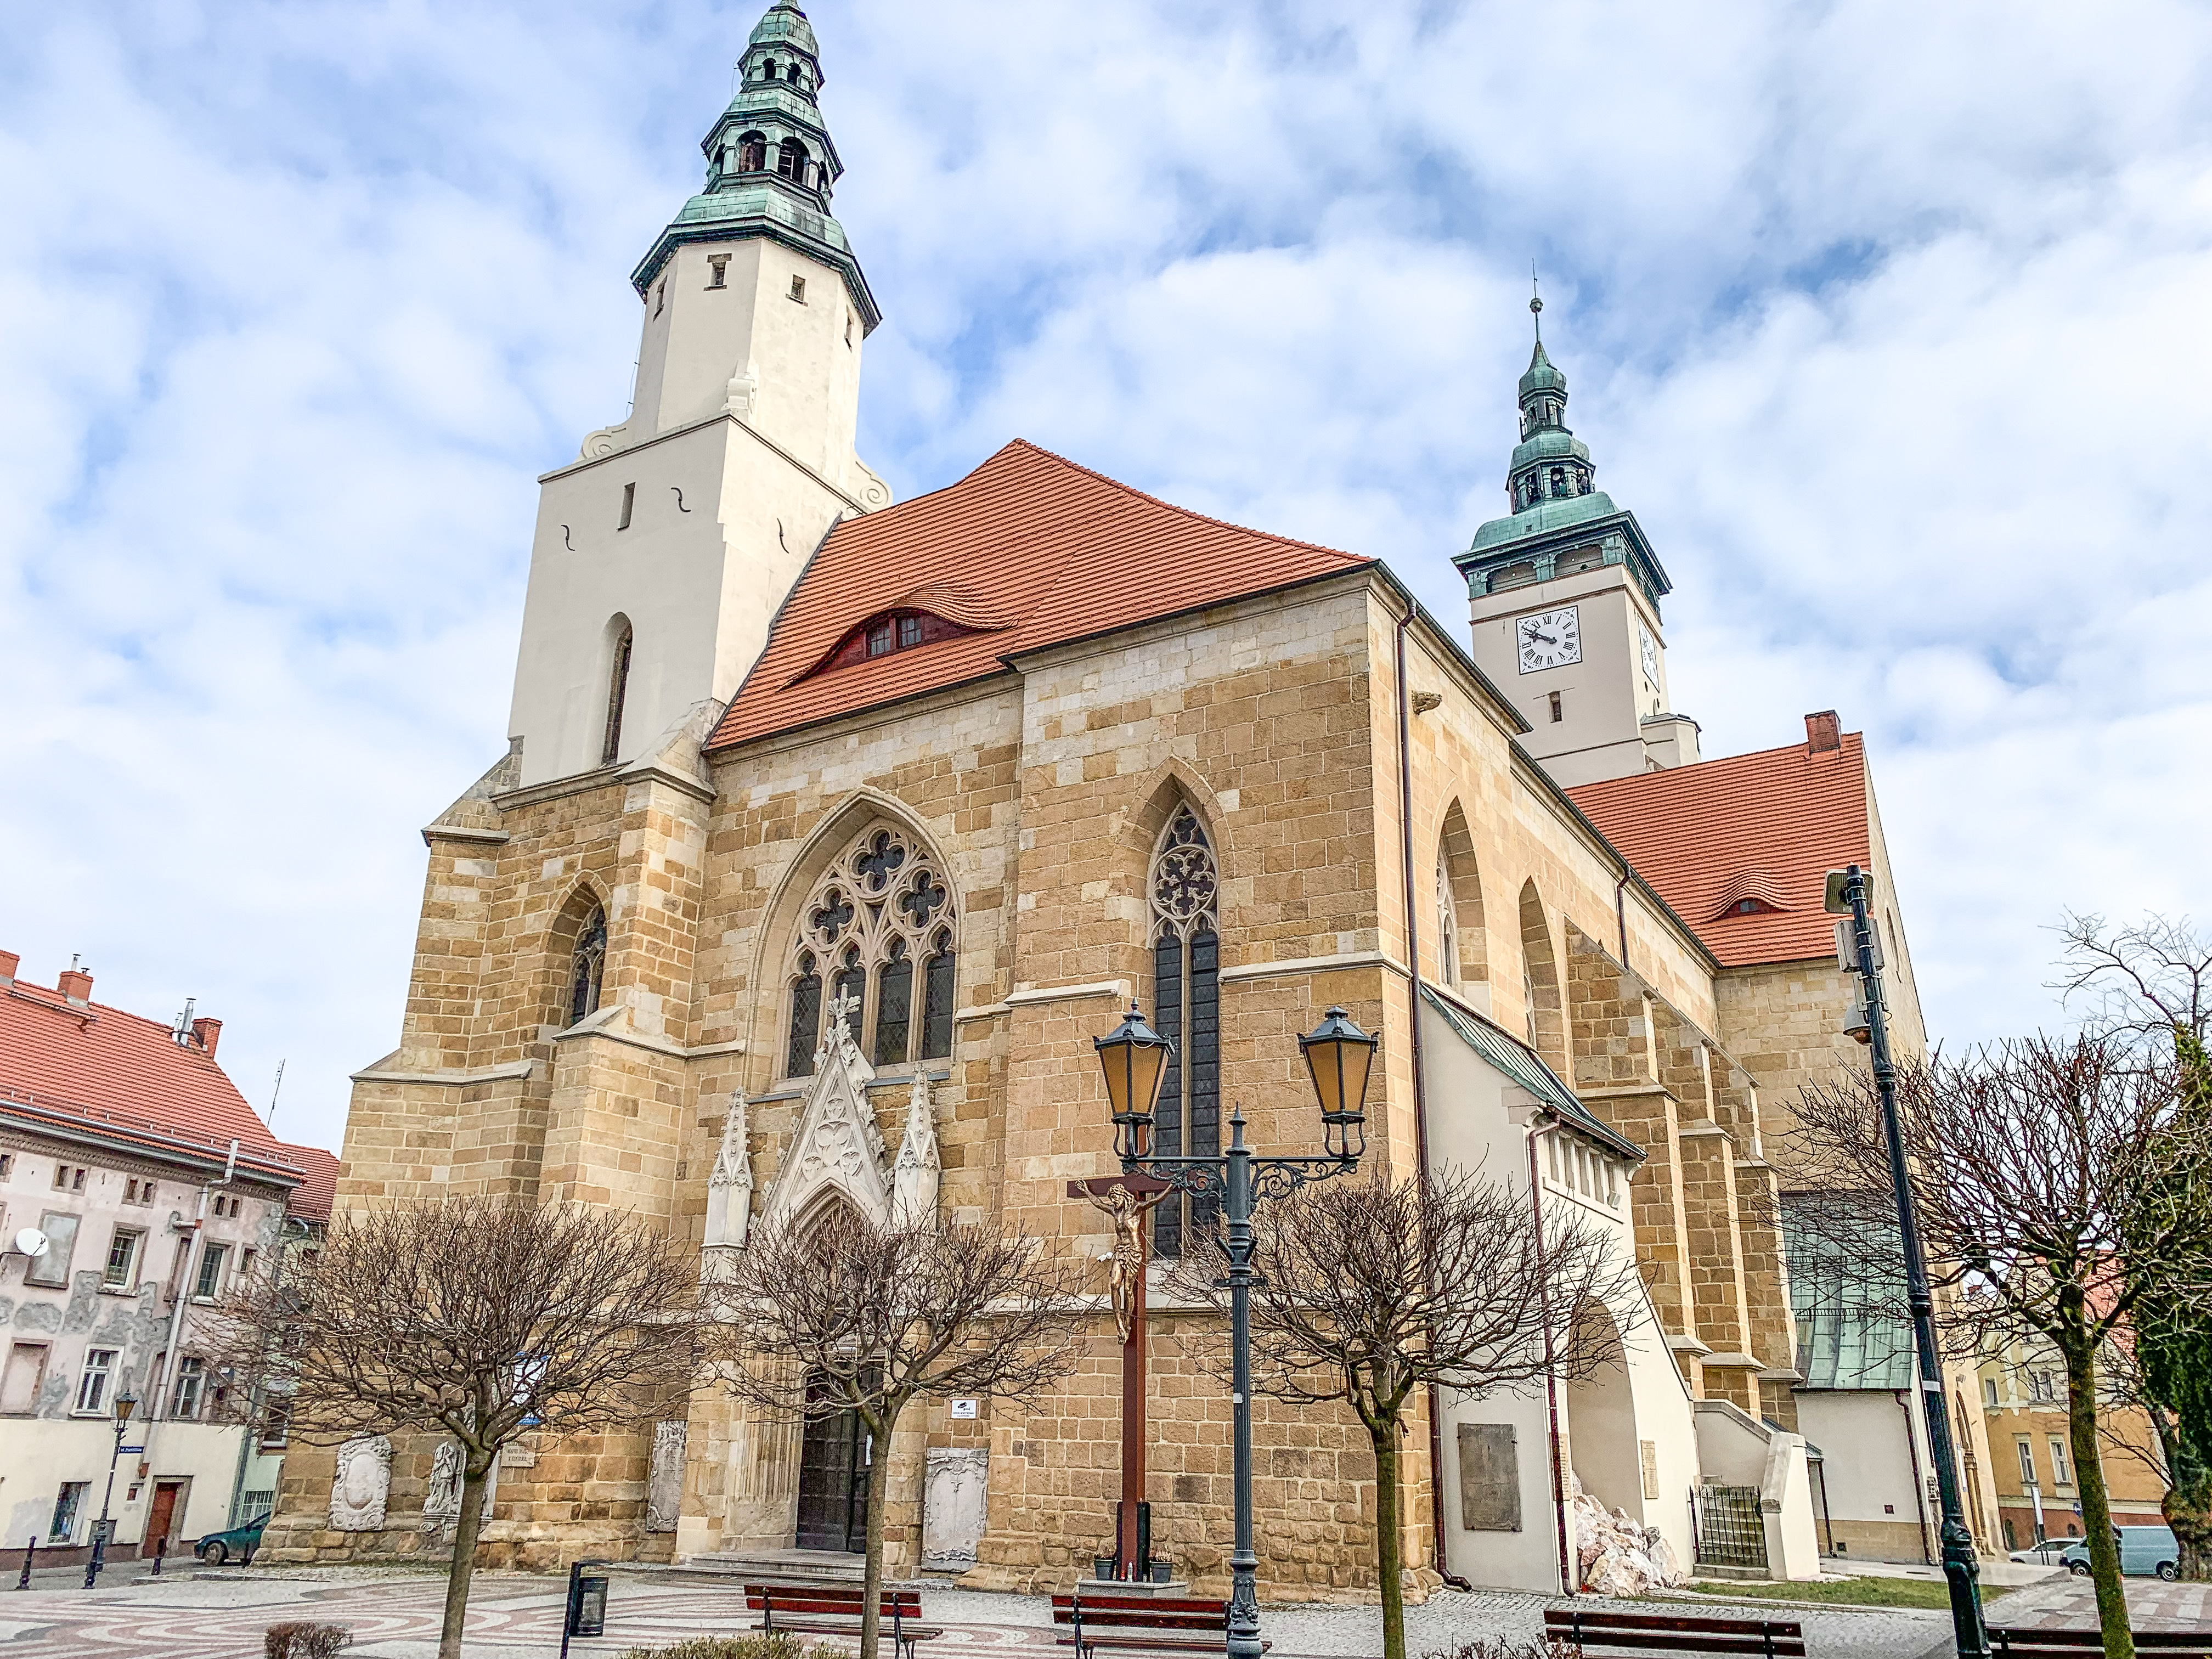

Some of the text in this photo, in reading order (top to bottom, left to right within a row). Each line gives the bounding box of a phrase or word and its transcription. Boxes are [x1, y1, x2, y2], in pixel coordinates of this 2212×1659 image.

[1532, 620, 1541, 629] XI
[1542, 616, 1551, 625] XII
[1555, 616, 1561, 625] I
[1562, 622, 1572, 630] II
[1562, 641, 1575, 651] IIII
[1524, 648, 1536, 661] VIII
[1558, 651, 1565, 659] V
[1533, 654, 1543, 665] VII
[1547, 656, 1553, 665] VI
